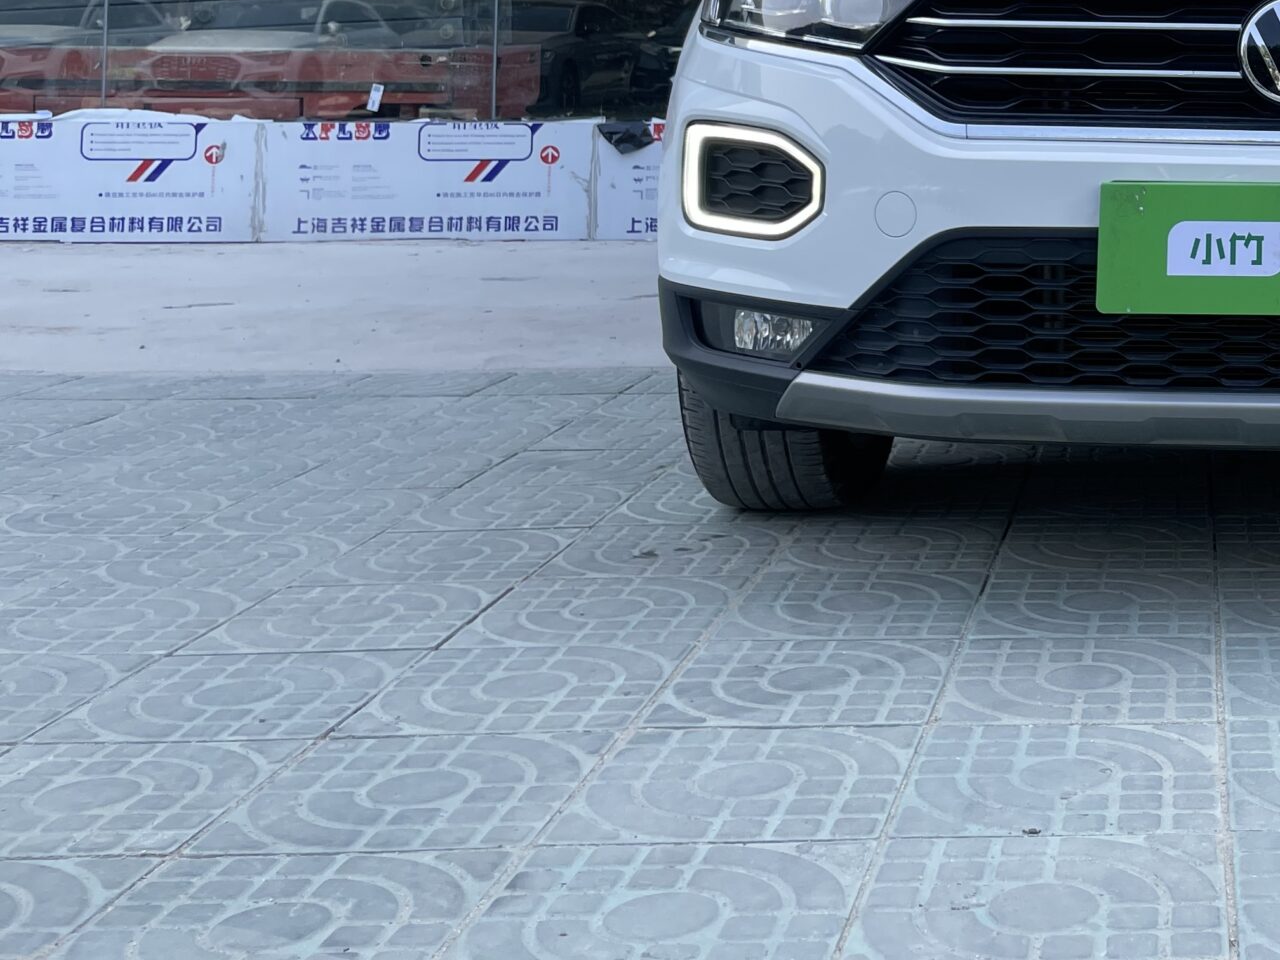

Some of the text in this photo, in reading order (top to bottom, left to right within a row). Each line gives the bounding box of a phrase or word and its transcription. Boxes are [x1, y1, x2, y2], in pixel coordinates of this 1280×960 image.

[292, 215, 559, 235] 上海吉祥金属复合材料有限公司
[1189, 233, 1265, 266] 小竹
